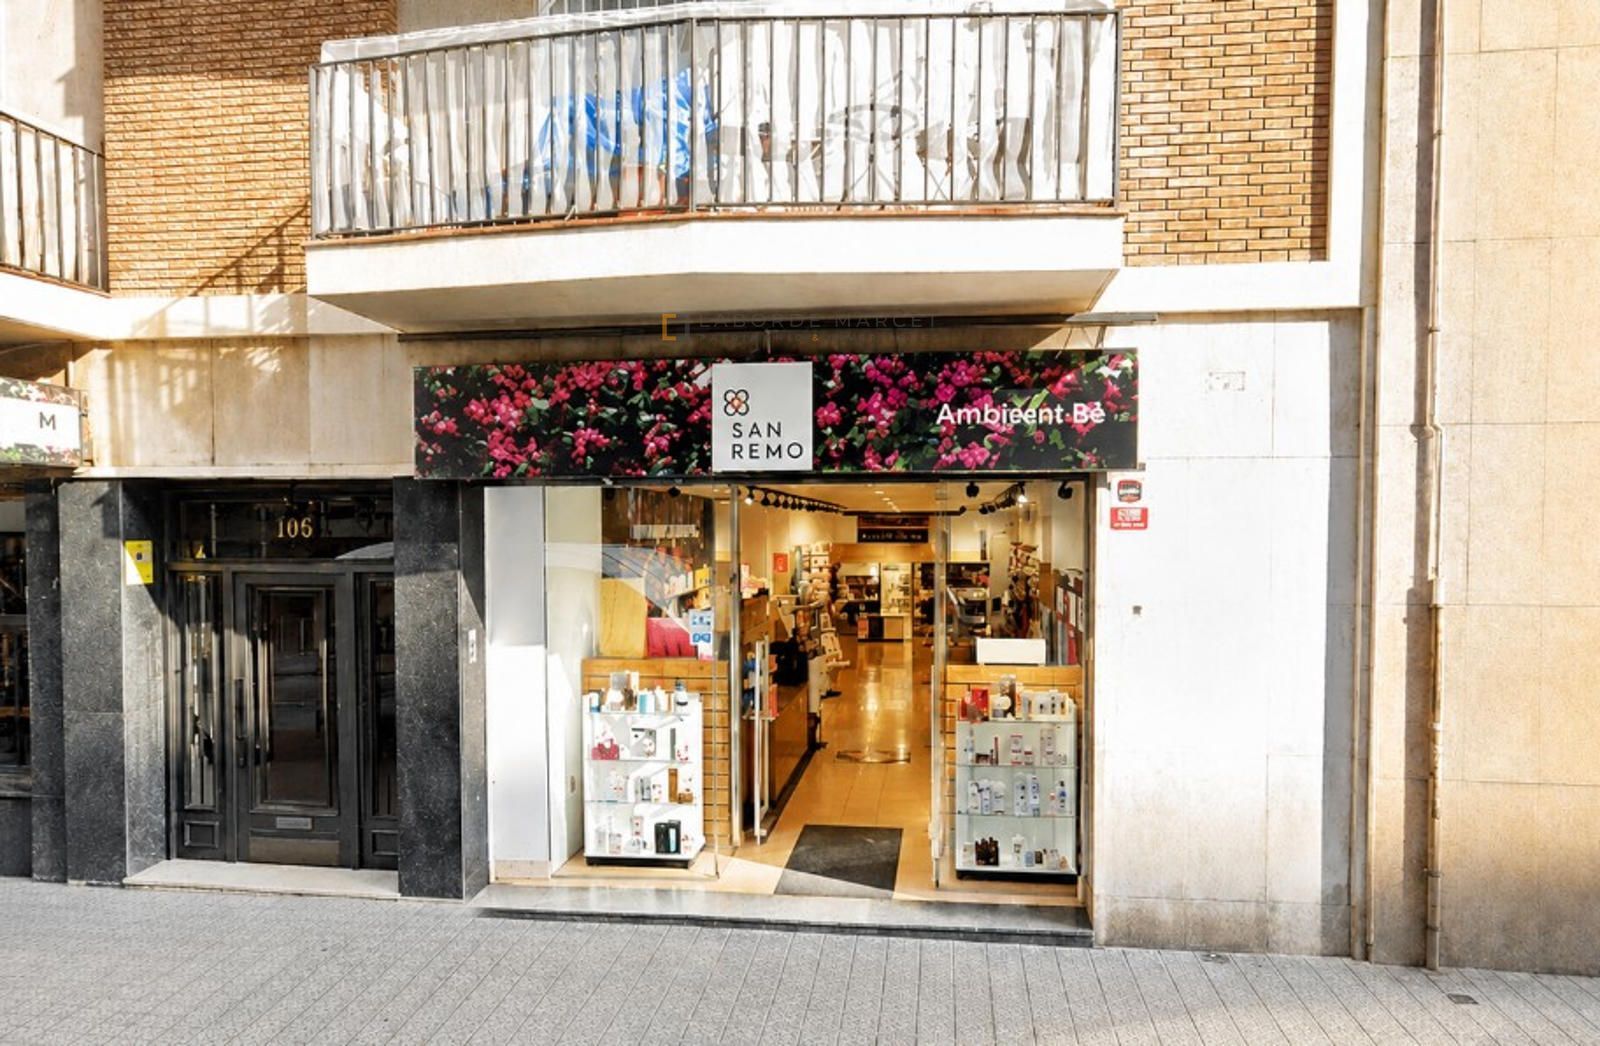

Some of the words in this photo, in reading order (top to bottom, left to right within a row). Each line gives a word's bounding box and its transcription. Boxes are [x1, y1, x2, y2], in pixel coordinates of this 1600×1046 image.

[39, 411, 56, 431] M
[732, 421, 781, 439] SAN
[731, 441, 803, 460] REMO
[277, 517, 313, 538] 106
